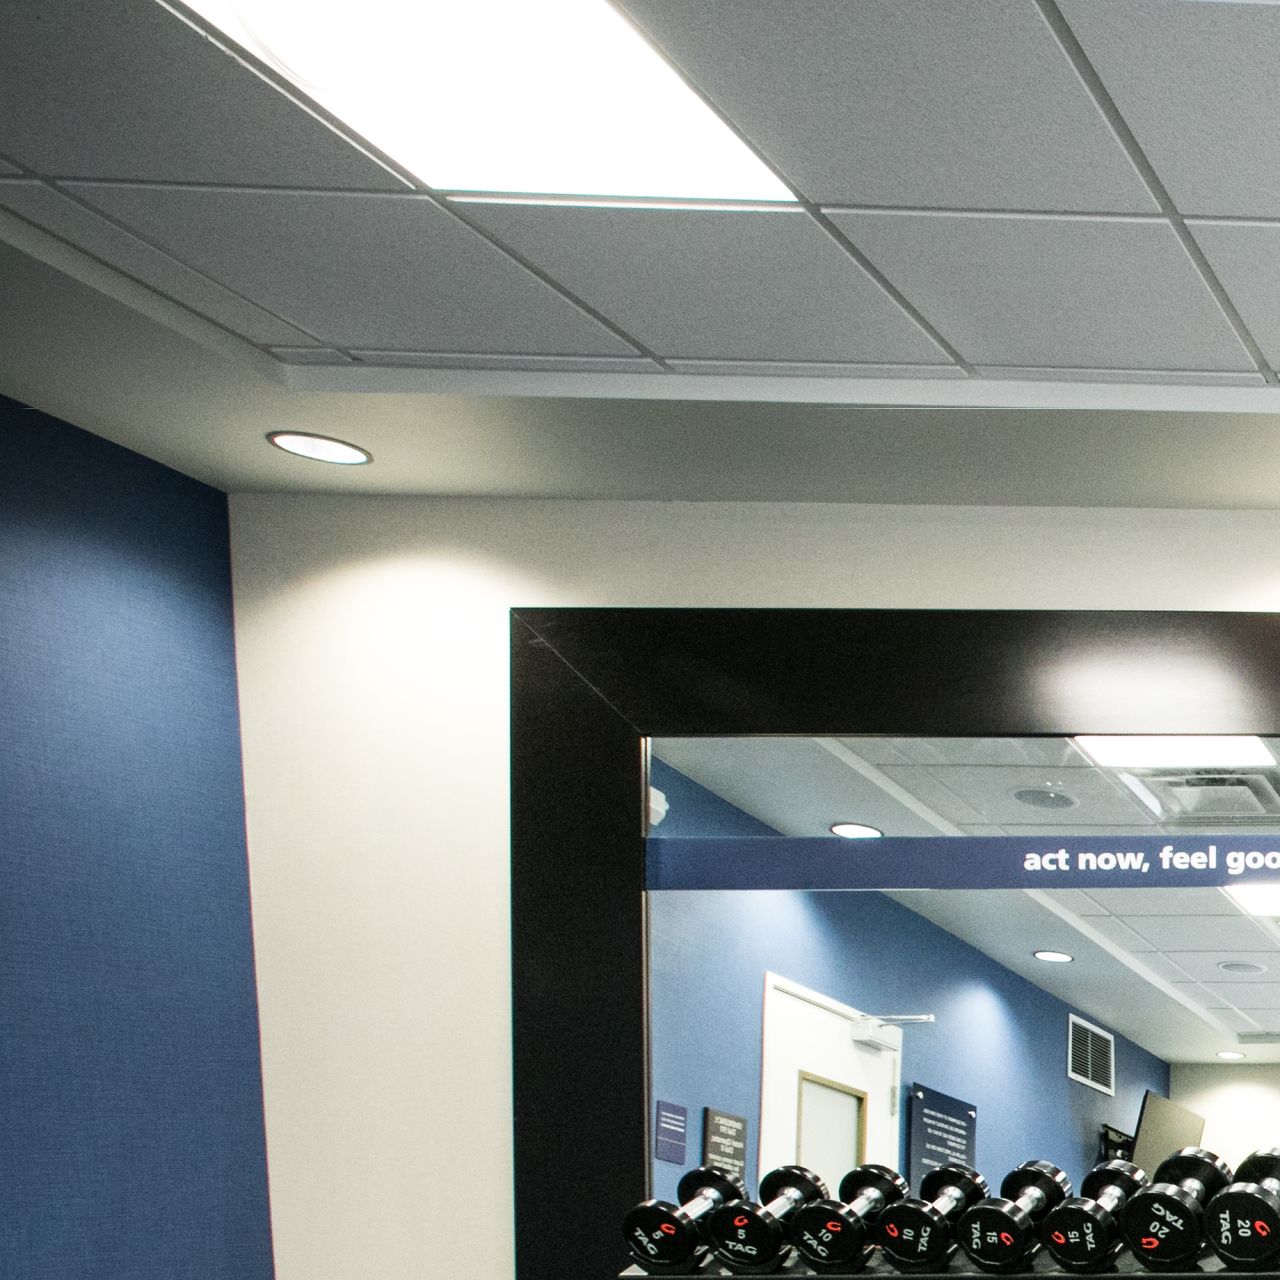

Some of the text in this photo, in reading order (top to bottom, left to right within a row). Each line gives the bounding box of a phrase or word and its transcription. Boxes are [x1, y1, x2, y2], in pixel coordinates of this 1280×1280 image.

[1023, 849, 1069, 871] act
[1078, 851, 1150, 873] now,
[1159, 846, 1217, 869] feel
[1151, 1203, 1185, 1230] TAG
[652, 1230, 664, 1240] 5
[737, 1229, 746, 1239] 5
[818, 1229, 832, 1242] 10
[902, 1228, 915, 1241] 10
[971, 1221, 982, 1250] TAG
[1149, 1221, 1170, 1239] 20
[1219, 1209, 1232, 1245] TAG
[1237, 1219, 1252, 1237] 20
[633, 1227, 658, 1255] TAG
[802, 1231, 830, 1257] TAG
[917, 1226, 931, 1253] TAG
[986, 1231, 998, 1244] 15
[1067, 1230, 1080, 1243] 15
[1083, 1222, 1096, 1251] TAG
[725, 1240, 758, 1256] TAG
